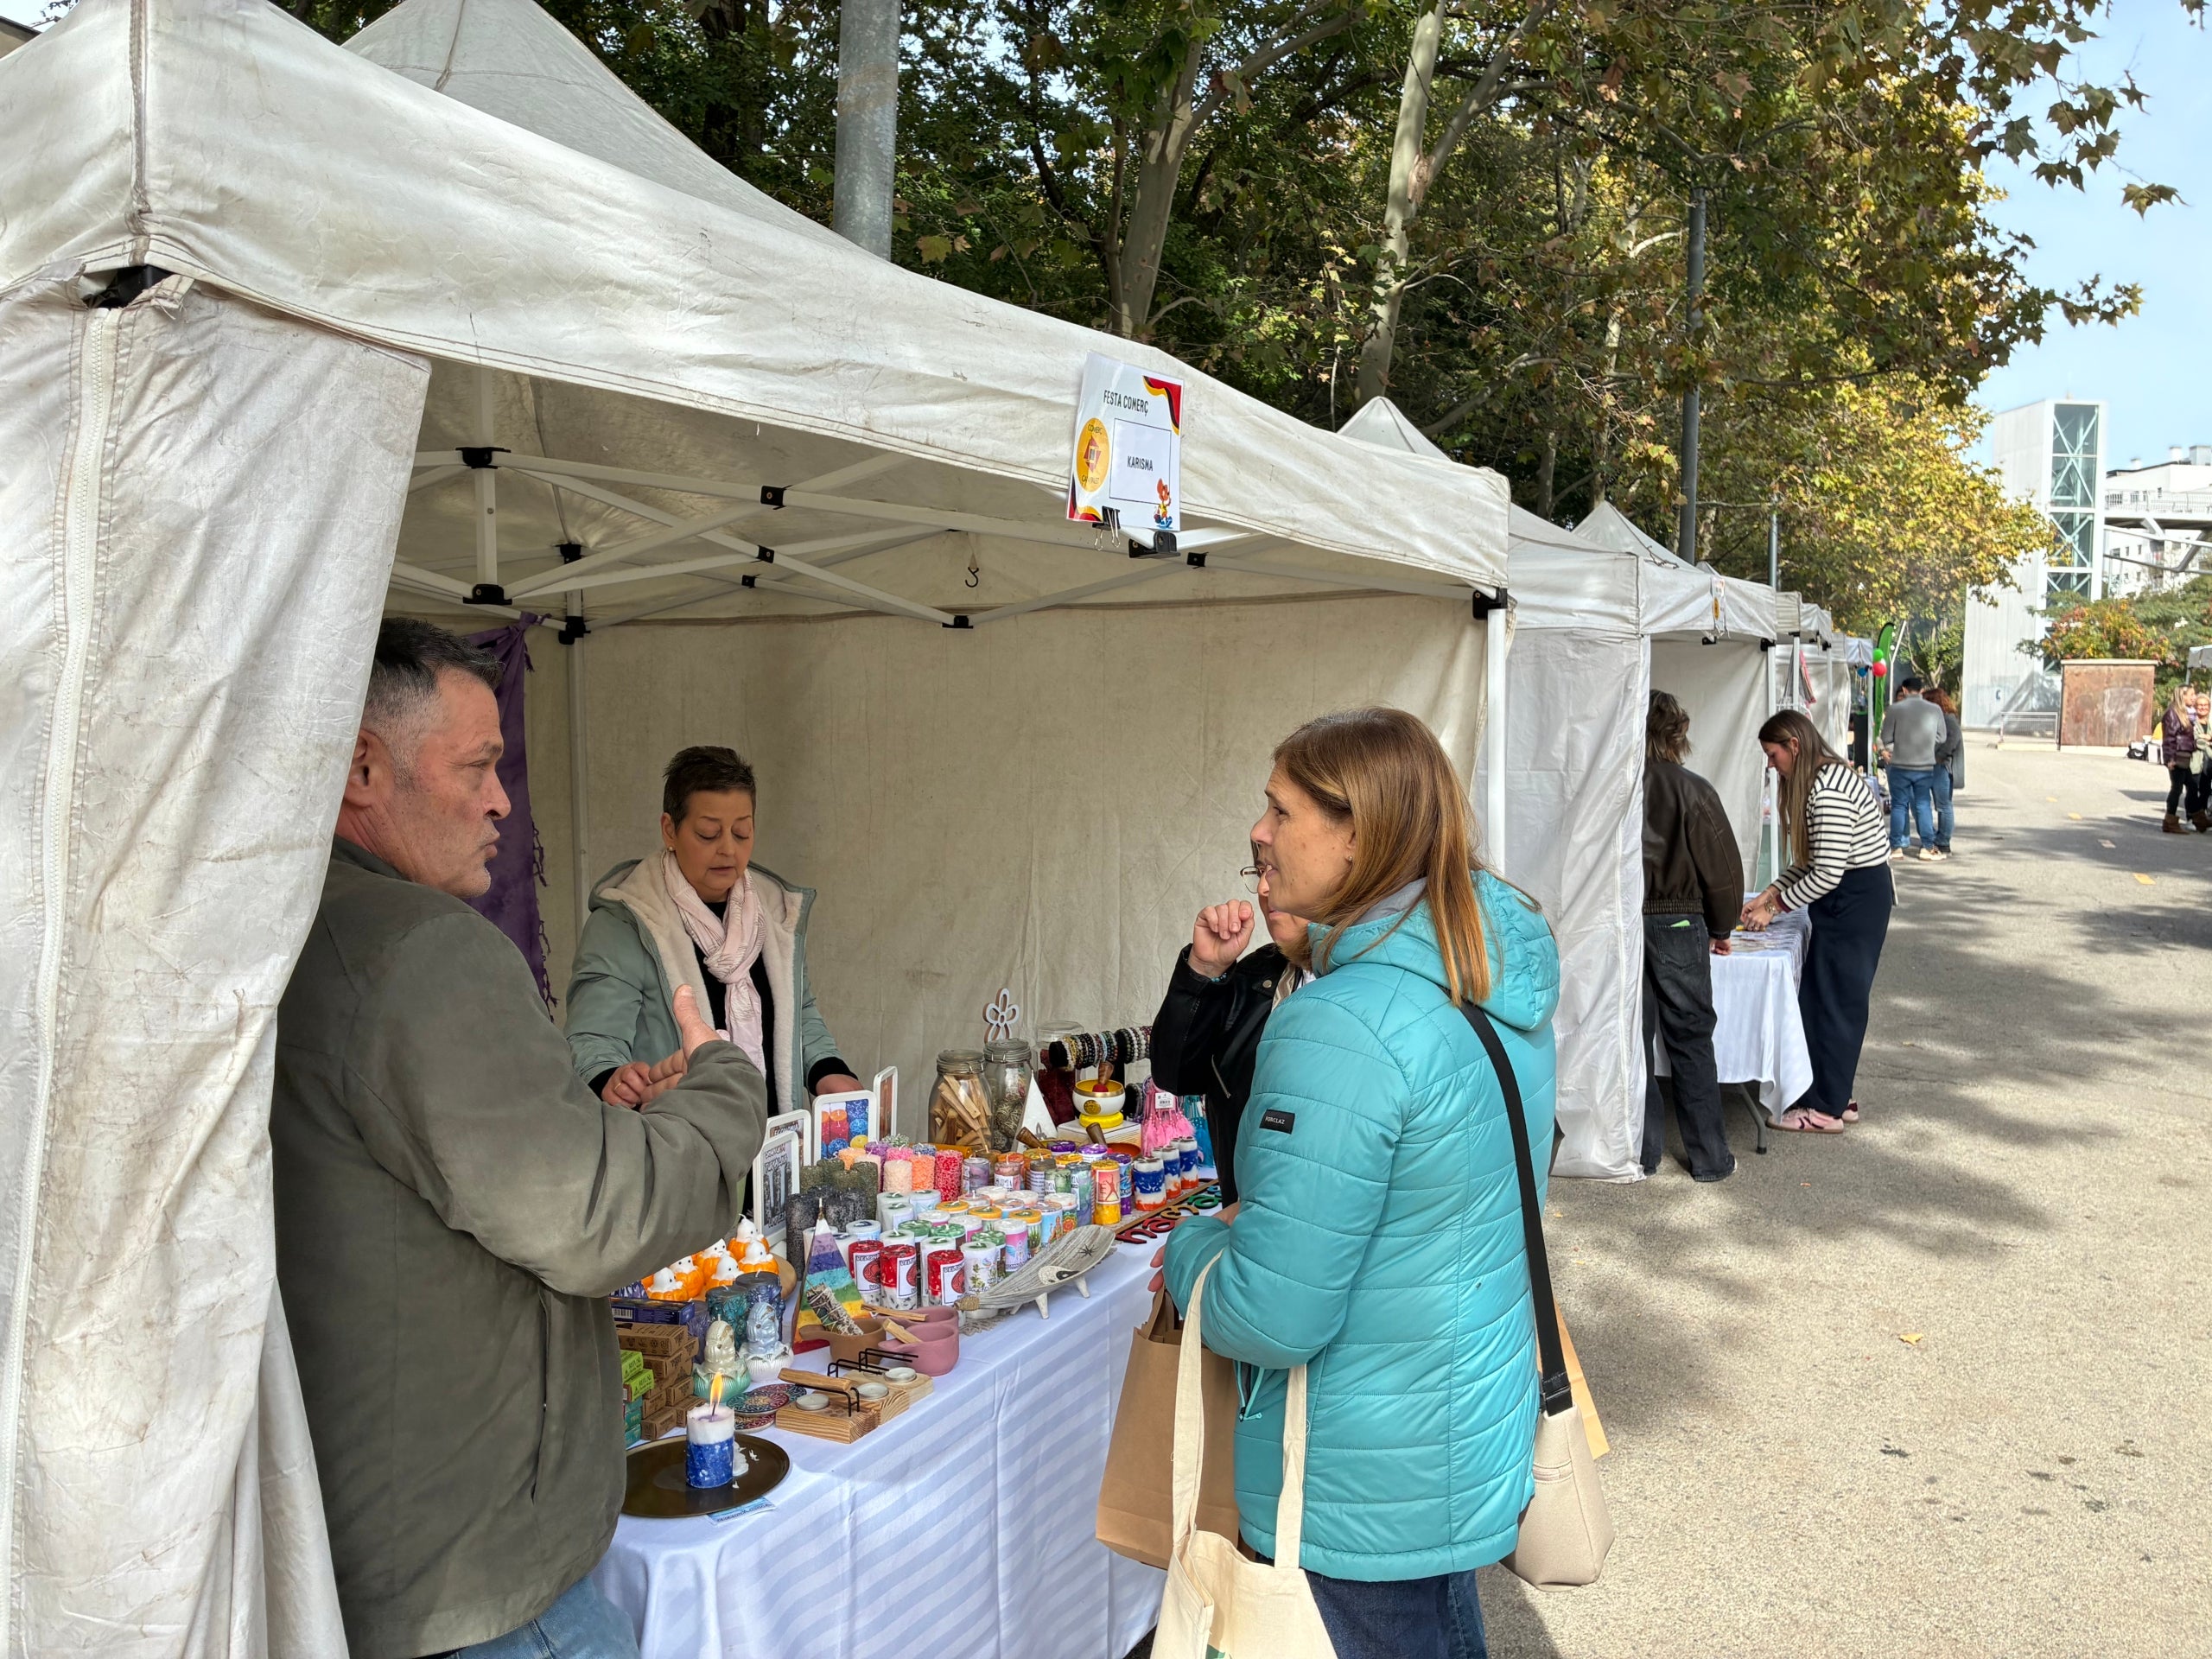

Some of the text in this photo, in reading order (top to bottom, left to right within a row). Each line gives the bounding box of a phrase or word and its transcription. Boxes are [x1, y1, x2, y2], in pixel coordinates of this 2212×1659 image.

[1103, 390, 1149, 416] FESTA COMERÇ
[1127, 455, 1154, 472] KARISMA
[1264, 1116, 1286, 1125] FORCLAZ
